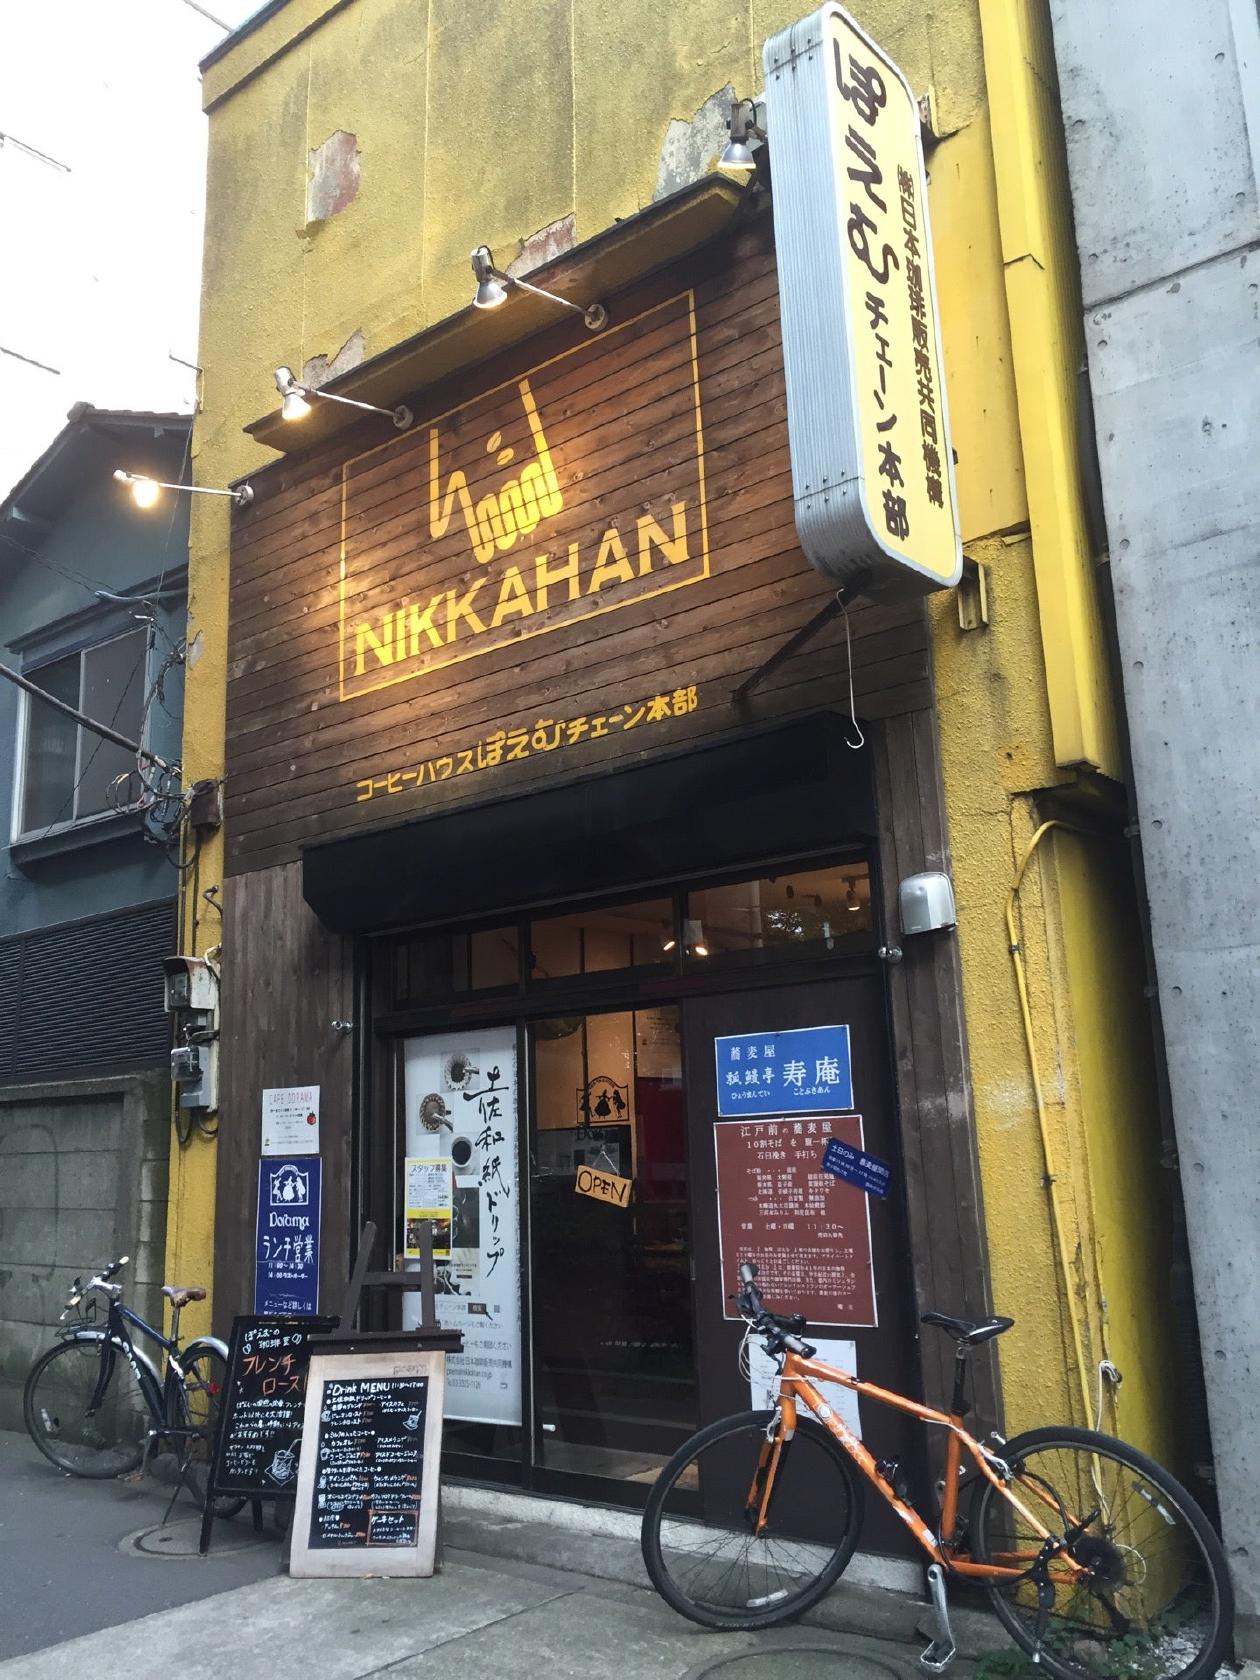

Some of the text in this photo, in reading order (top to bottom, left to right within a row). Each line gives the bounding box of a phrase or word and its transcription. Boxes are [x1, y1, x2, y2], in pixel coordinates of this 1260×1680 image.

[833, 37, 910, 542] ぽえむチェーン本部
[353, 500, 691, 676] NIKKAHAN
[356, 683, 698, 801] コーヒーハウスぽえむチェーン本部
[730, 1044, 776, 1061] 蕎麦屋
[783, 1055, 841, 1087] 寿庵
[463, 1065, 509, 1278] 土佐和紙ドリップ
[577, 1170, 627, 1203] OPEN
[269, 1211, 310, 1231] Dorama
[263, 1234, 315, 1264] ランチ営業
[241, 1353, 297, 1377] フレンチ
[332, 1382, 358, 1396] Drink
[360, 1382, 391, 1394] MENU
